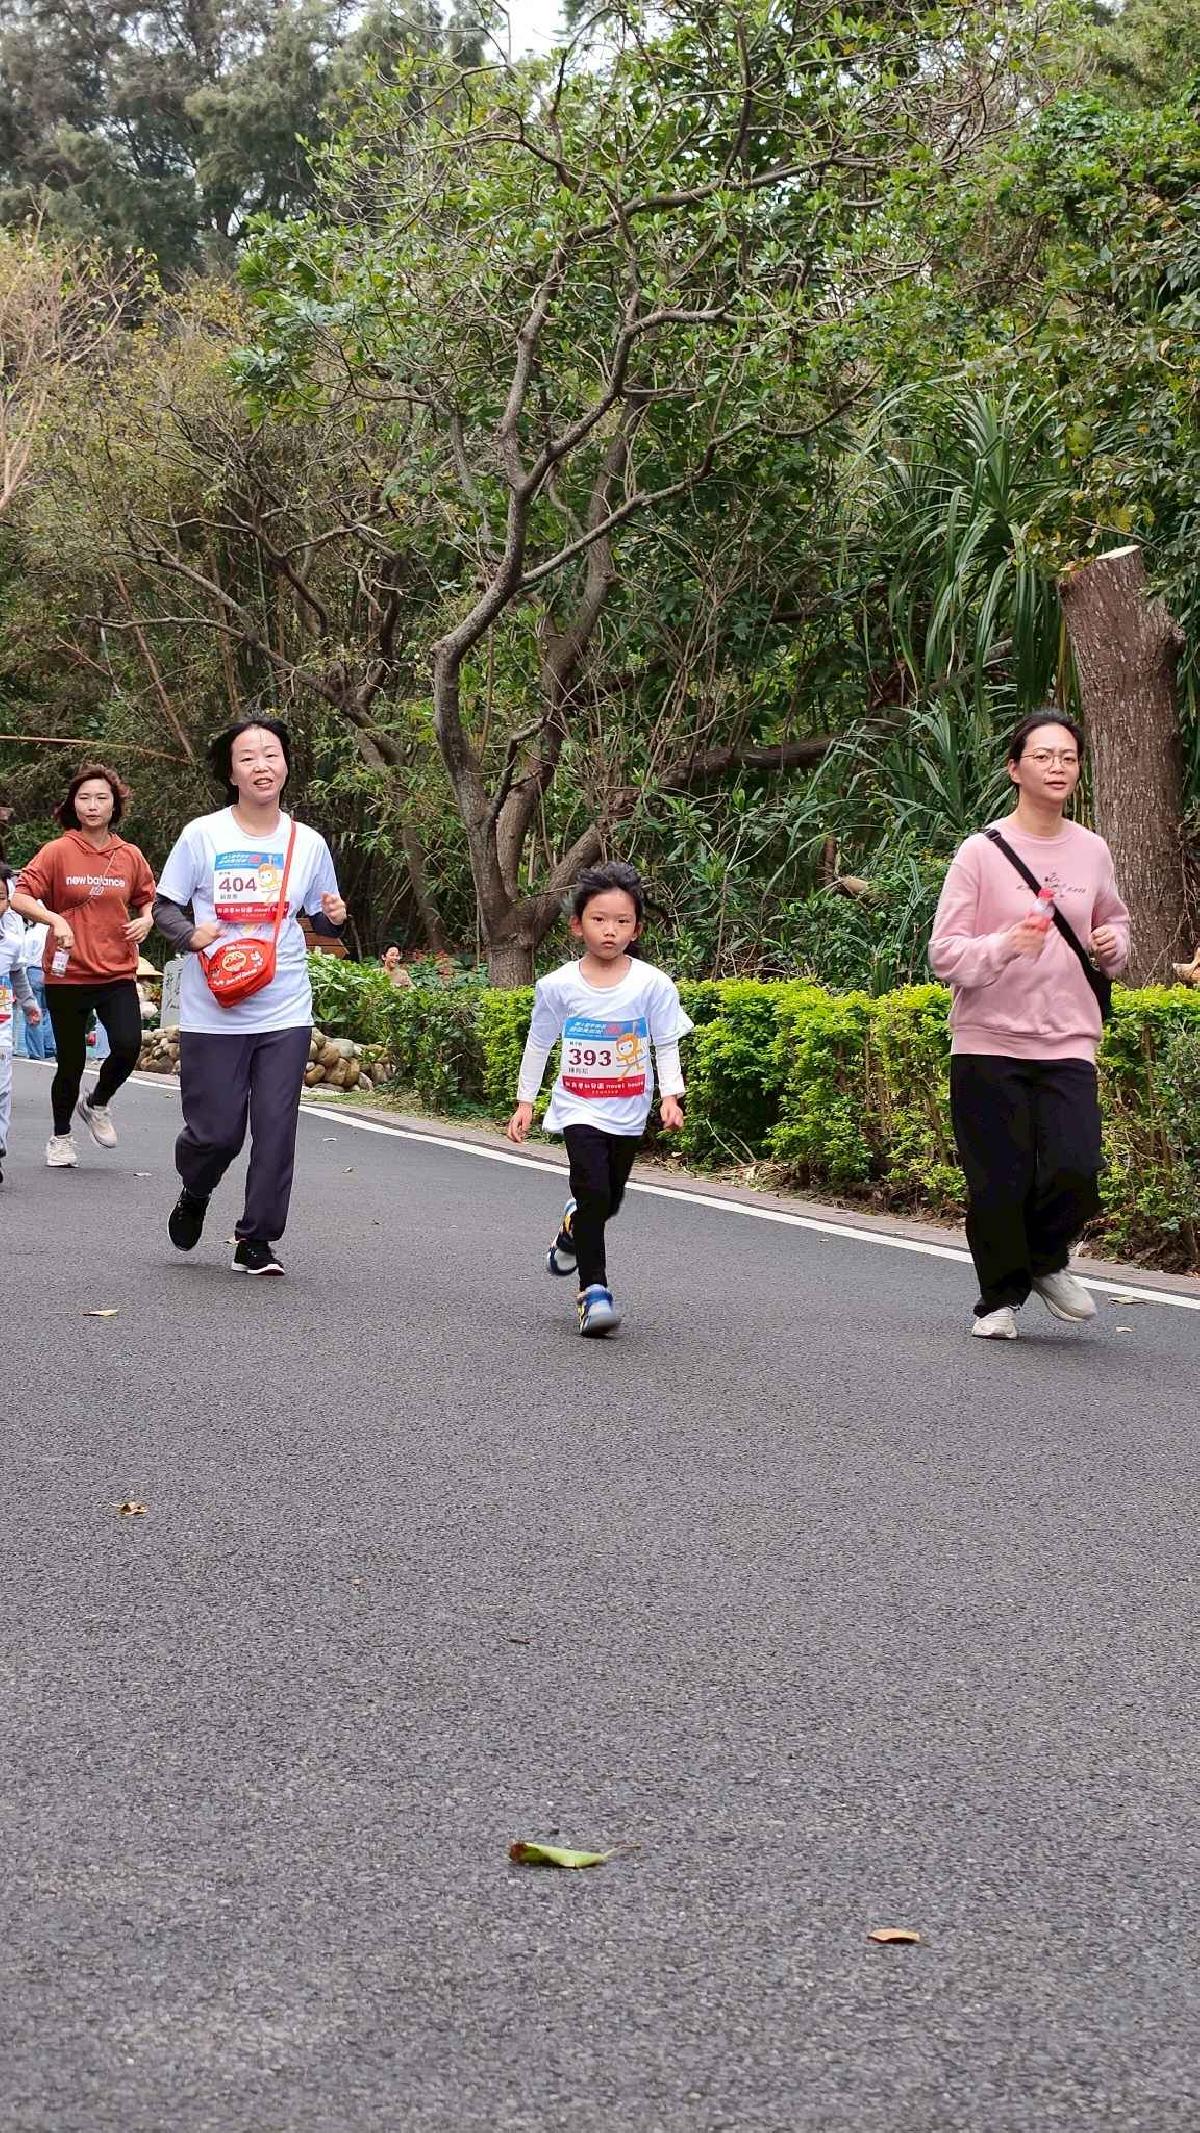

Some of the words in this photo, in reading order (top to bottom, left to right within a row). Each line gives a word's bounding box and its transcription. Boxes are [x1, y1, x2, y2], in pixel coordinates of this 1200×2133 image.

[65, 875, 86, 886] new
[87, 873, 126, 888] balance
[218, 876, 257, 893] 404
[568, 1048, 612, 1067] 393
